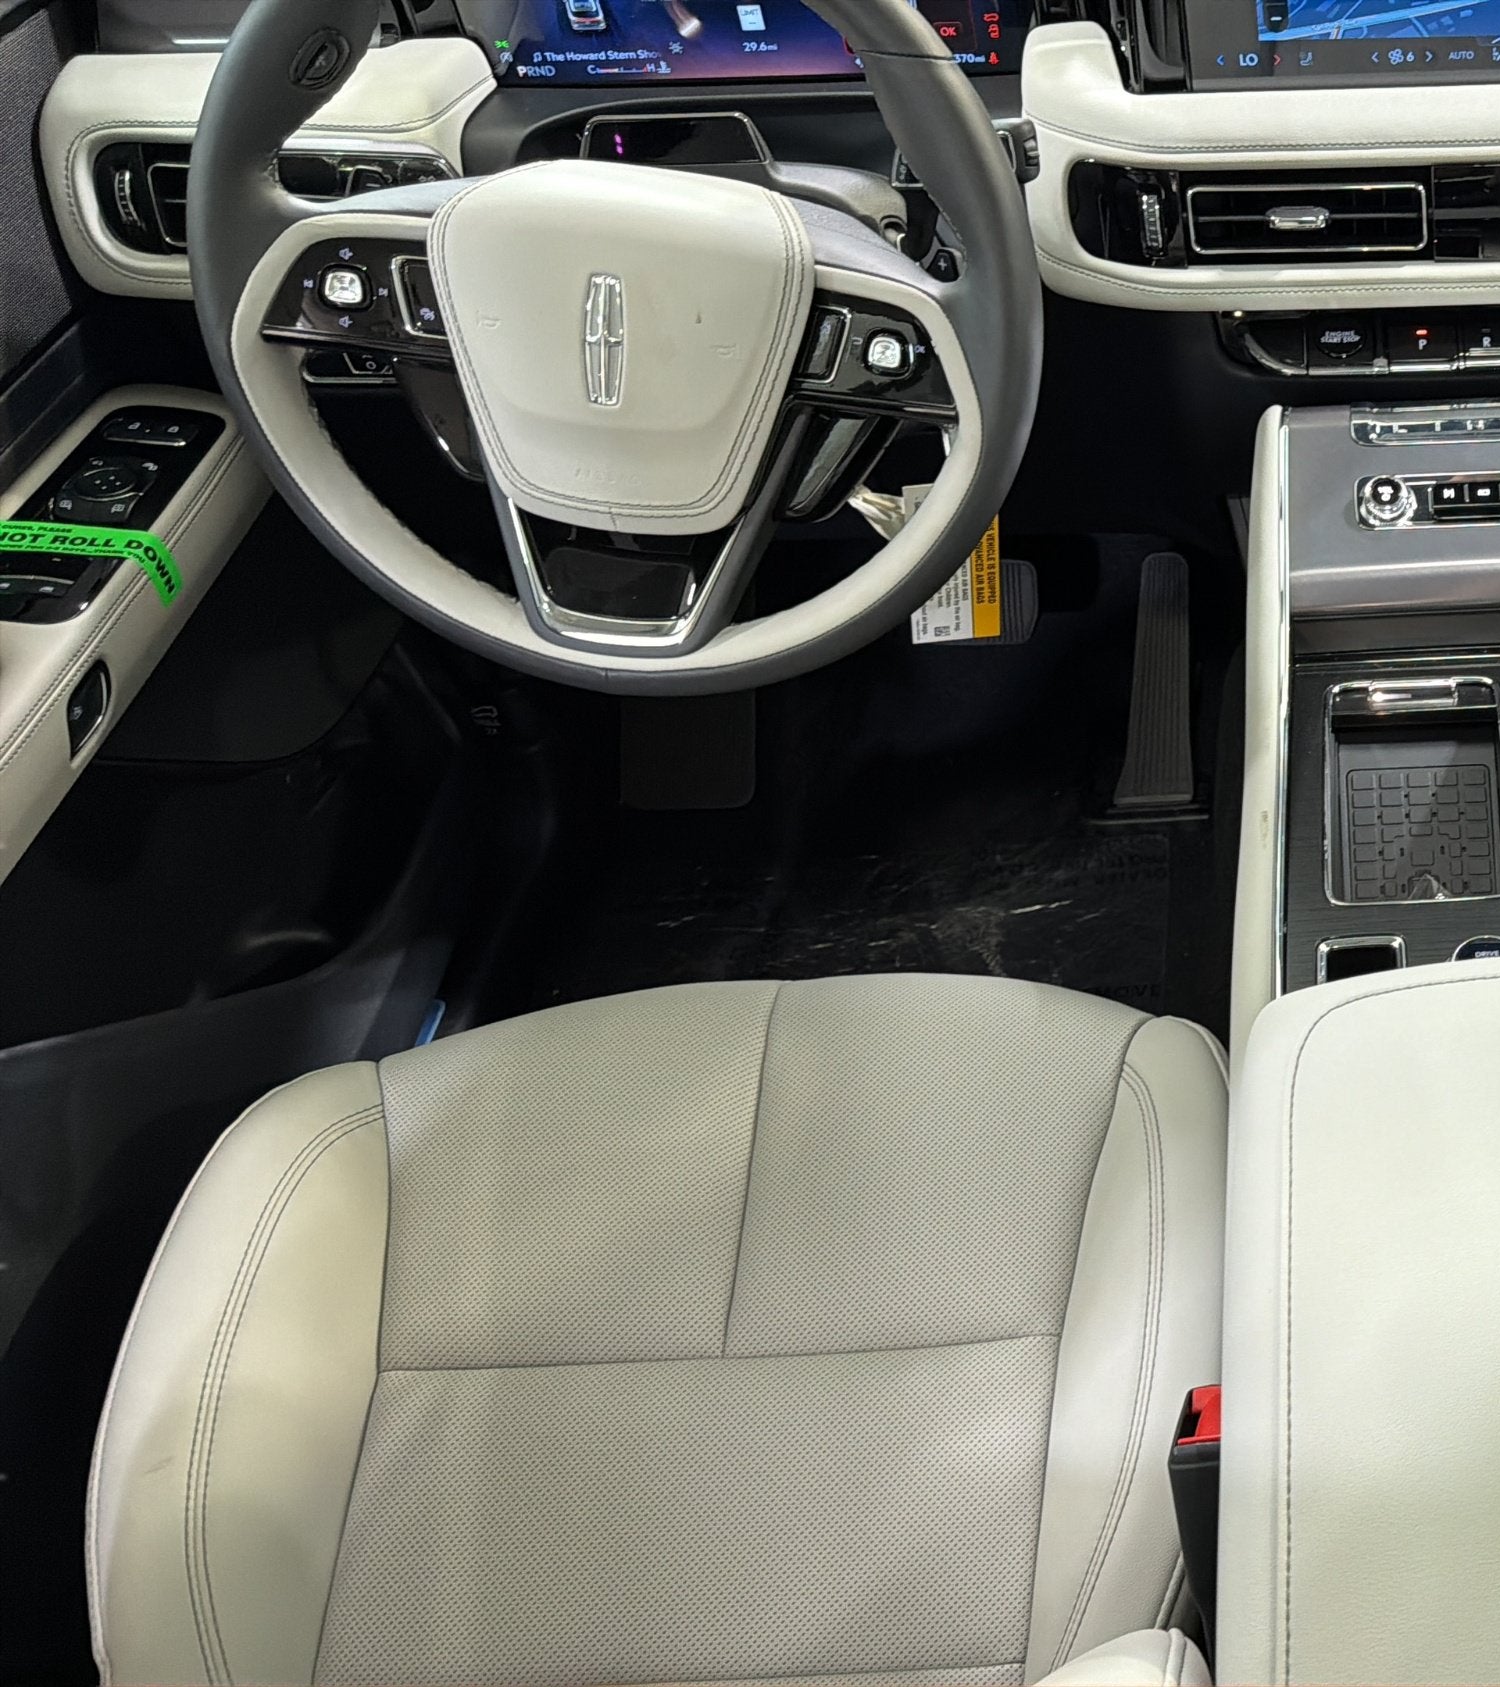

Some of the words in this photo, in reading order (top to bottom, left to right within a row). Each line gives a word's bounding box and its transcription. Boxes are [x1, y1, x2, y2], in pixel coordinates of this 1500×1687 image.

[939, 27, 957, 37] OK
[545, 52, 565, 62] The
[566, 51, 606, 62] Howard
[607, 50, 637, 60] Stern
[638, 49, 662, 60] Sho
[1238, 53, 1258, 66] LO
[1406, 51, 1415, 62] 6
[1448, 51, 1475, 61] AUTO
[1320, 335, 1342, 343] START
[1325, 330, 1355, 338] ENGINE
[1418, 339, 1428, 350] P
[1482, 336, 1492, 348] R
[987, 533, 996, 562] VEHICLE
[975, 541, 984, 573] DVANCED
[50, 535, 116, 547] ROLL
[123, 539, 176, 595] DOWN
[987, 563, 996, 571] IS
[976, 574, 985, 586] AIR
[987, 572, 997, 604] EQUIPPED
[976, 587, 986, 604] BAGS
[1474, 950, 1500, 958] DRIVE
